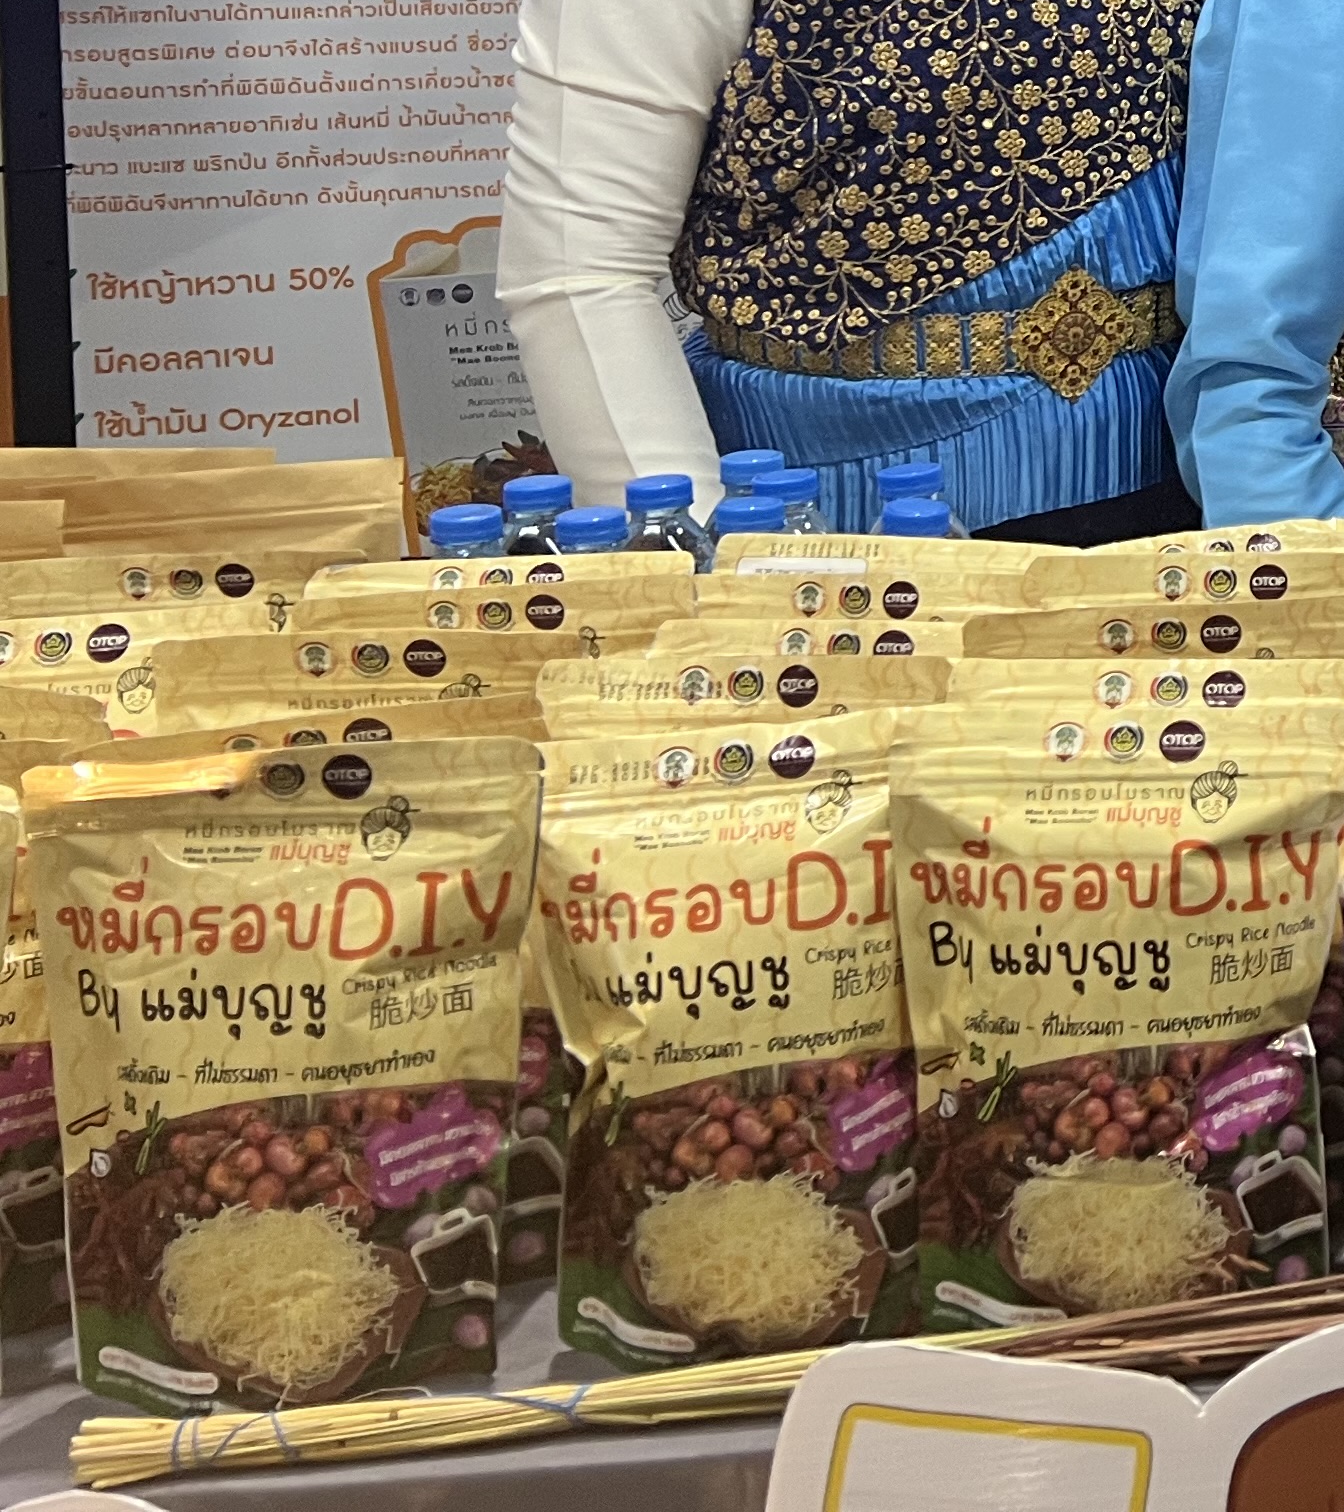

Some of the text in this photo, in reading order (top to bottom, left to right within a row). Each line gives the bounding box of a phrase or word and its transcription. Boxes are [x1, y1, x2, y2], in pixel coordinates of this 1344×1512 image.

[86, 265, 354, 304] ใช้หญ้าหวาน 50%
[94, 345, 275, 375] มีคอลลาเจน
[94, 398, 360, 439] ใช้น้ำมัน Oryzanol
[1162, 732, 1203, 748] OTOP
[928, 920, 1172, 995] By แม่บุญชู
[1185, 931, 1234, 950] Crispy
[1240, 926, 1270, 944] Rice
[77, 968, 121, 1032] By
[140, 968, 328, 1040] แม่บุญชู
[604, 952, 790, 1020] แม่บุญชู
